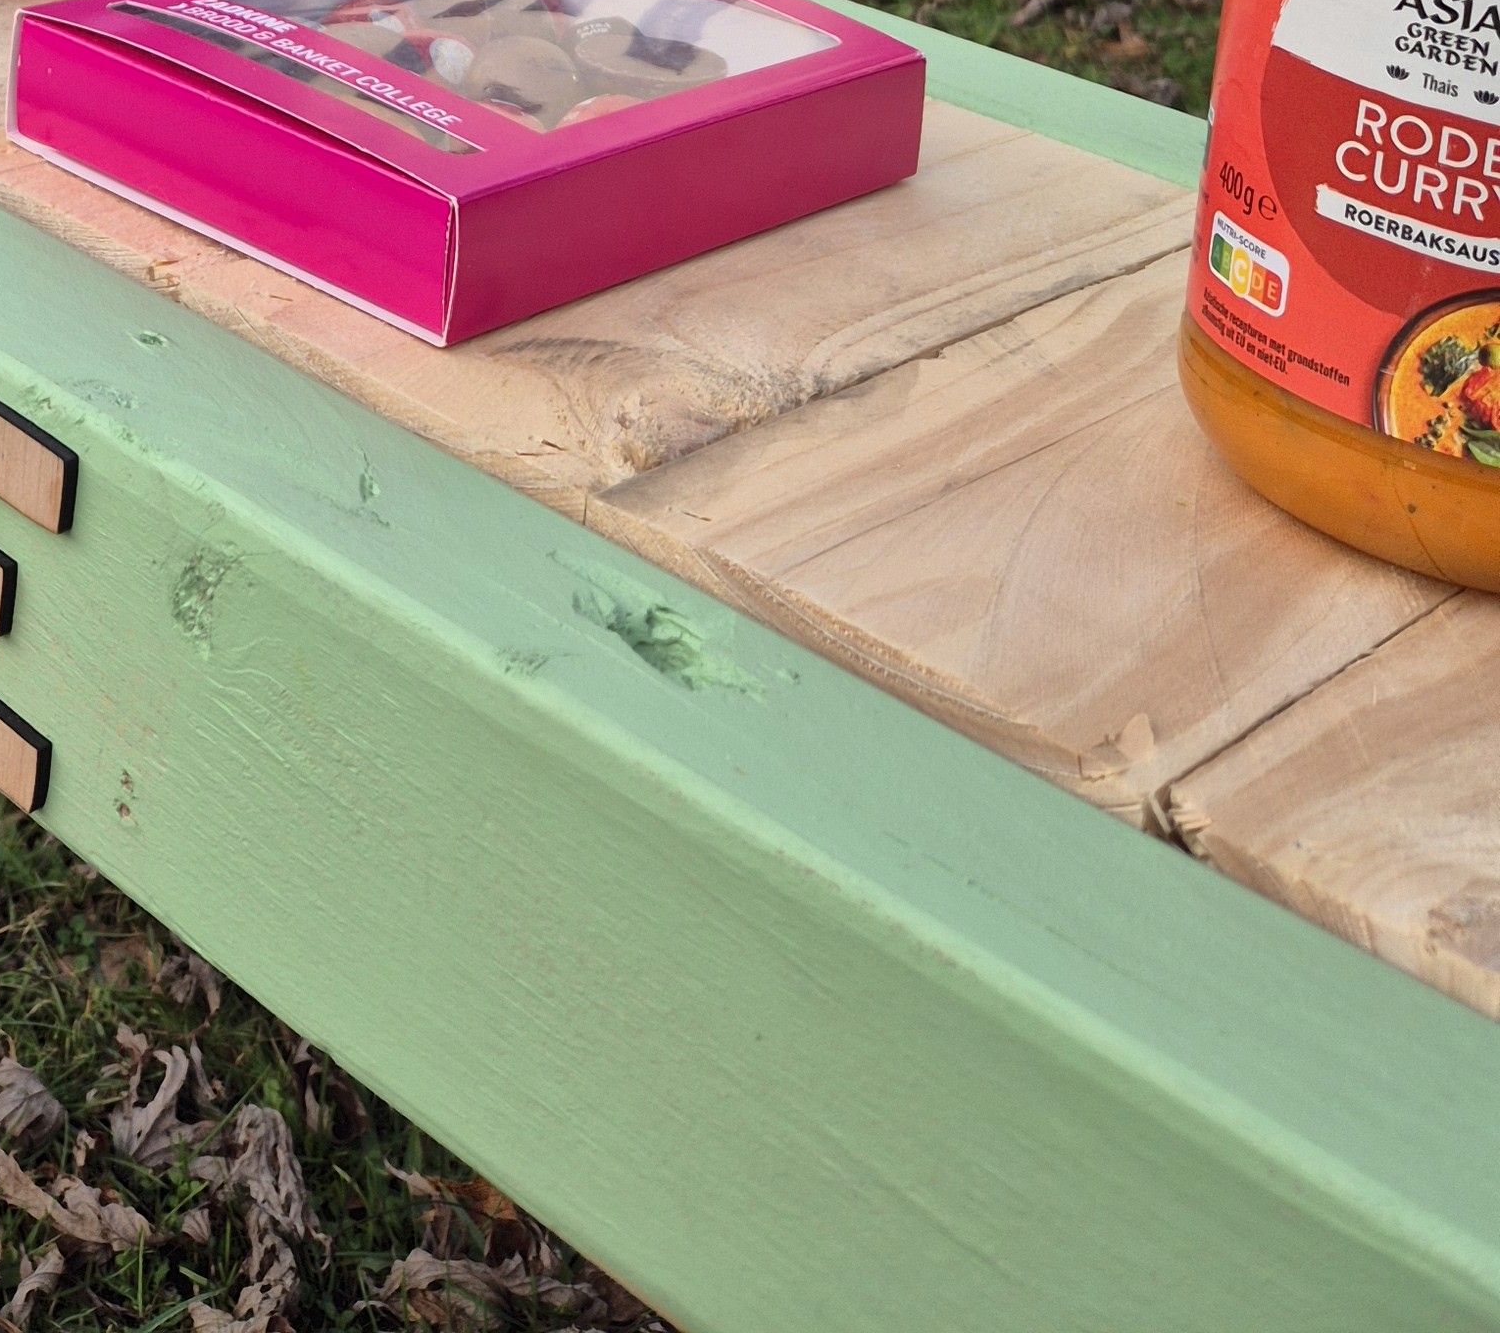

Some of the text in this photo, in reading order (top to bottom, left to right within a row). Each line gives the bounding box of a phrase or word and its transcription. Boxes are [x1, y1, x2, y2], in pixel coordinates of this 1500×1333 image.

[1395, 35, 1498, 77] GARDEN
[1407, 22, 1490, 57] GREEN
[182, 6, 258, 34] BROOD
[269, 37, 363, 77] BANKET
[356, 75, 463, 126] COLLEGE
[1422, 72, 1459, 98] Thais
[1355, 98, 1500, 180] RODE
[1335, 140, 1500, 222] CURR
[1216, 217, 1267, 260] NUTRI-SCORE
[1228, 312, 1268, 345] recepturen
[1268, 338, 1286, 356] met
[1287, 349, 1350, 387] grondstoffen
[1235, 332, 1246, 348] EU
